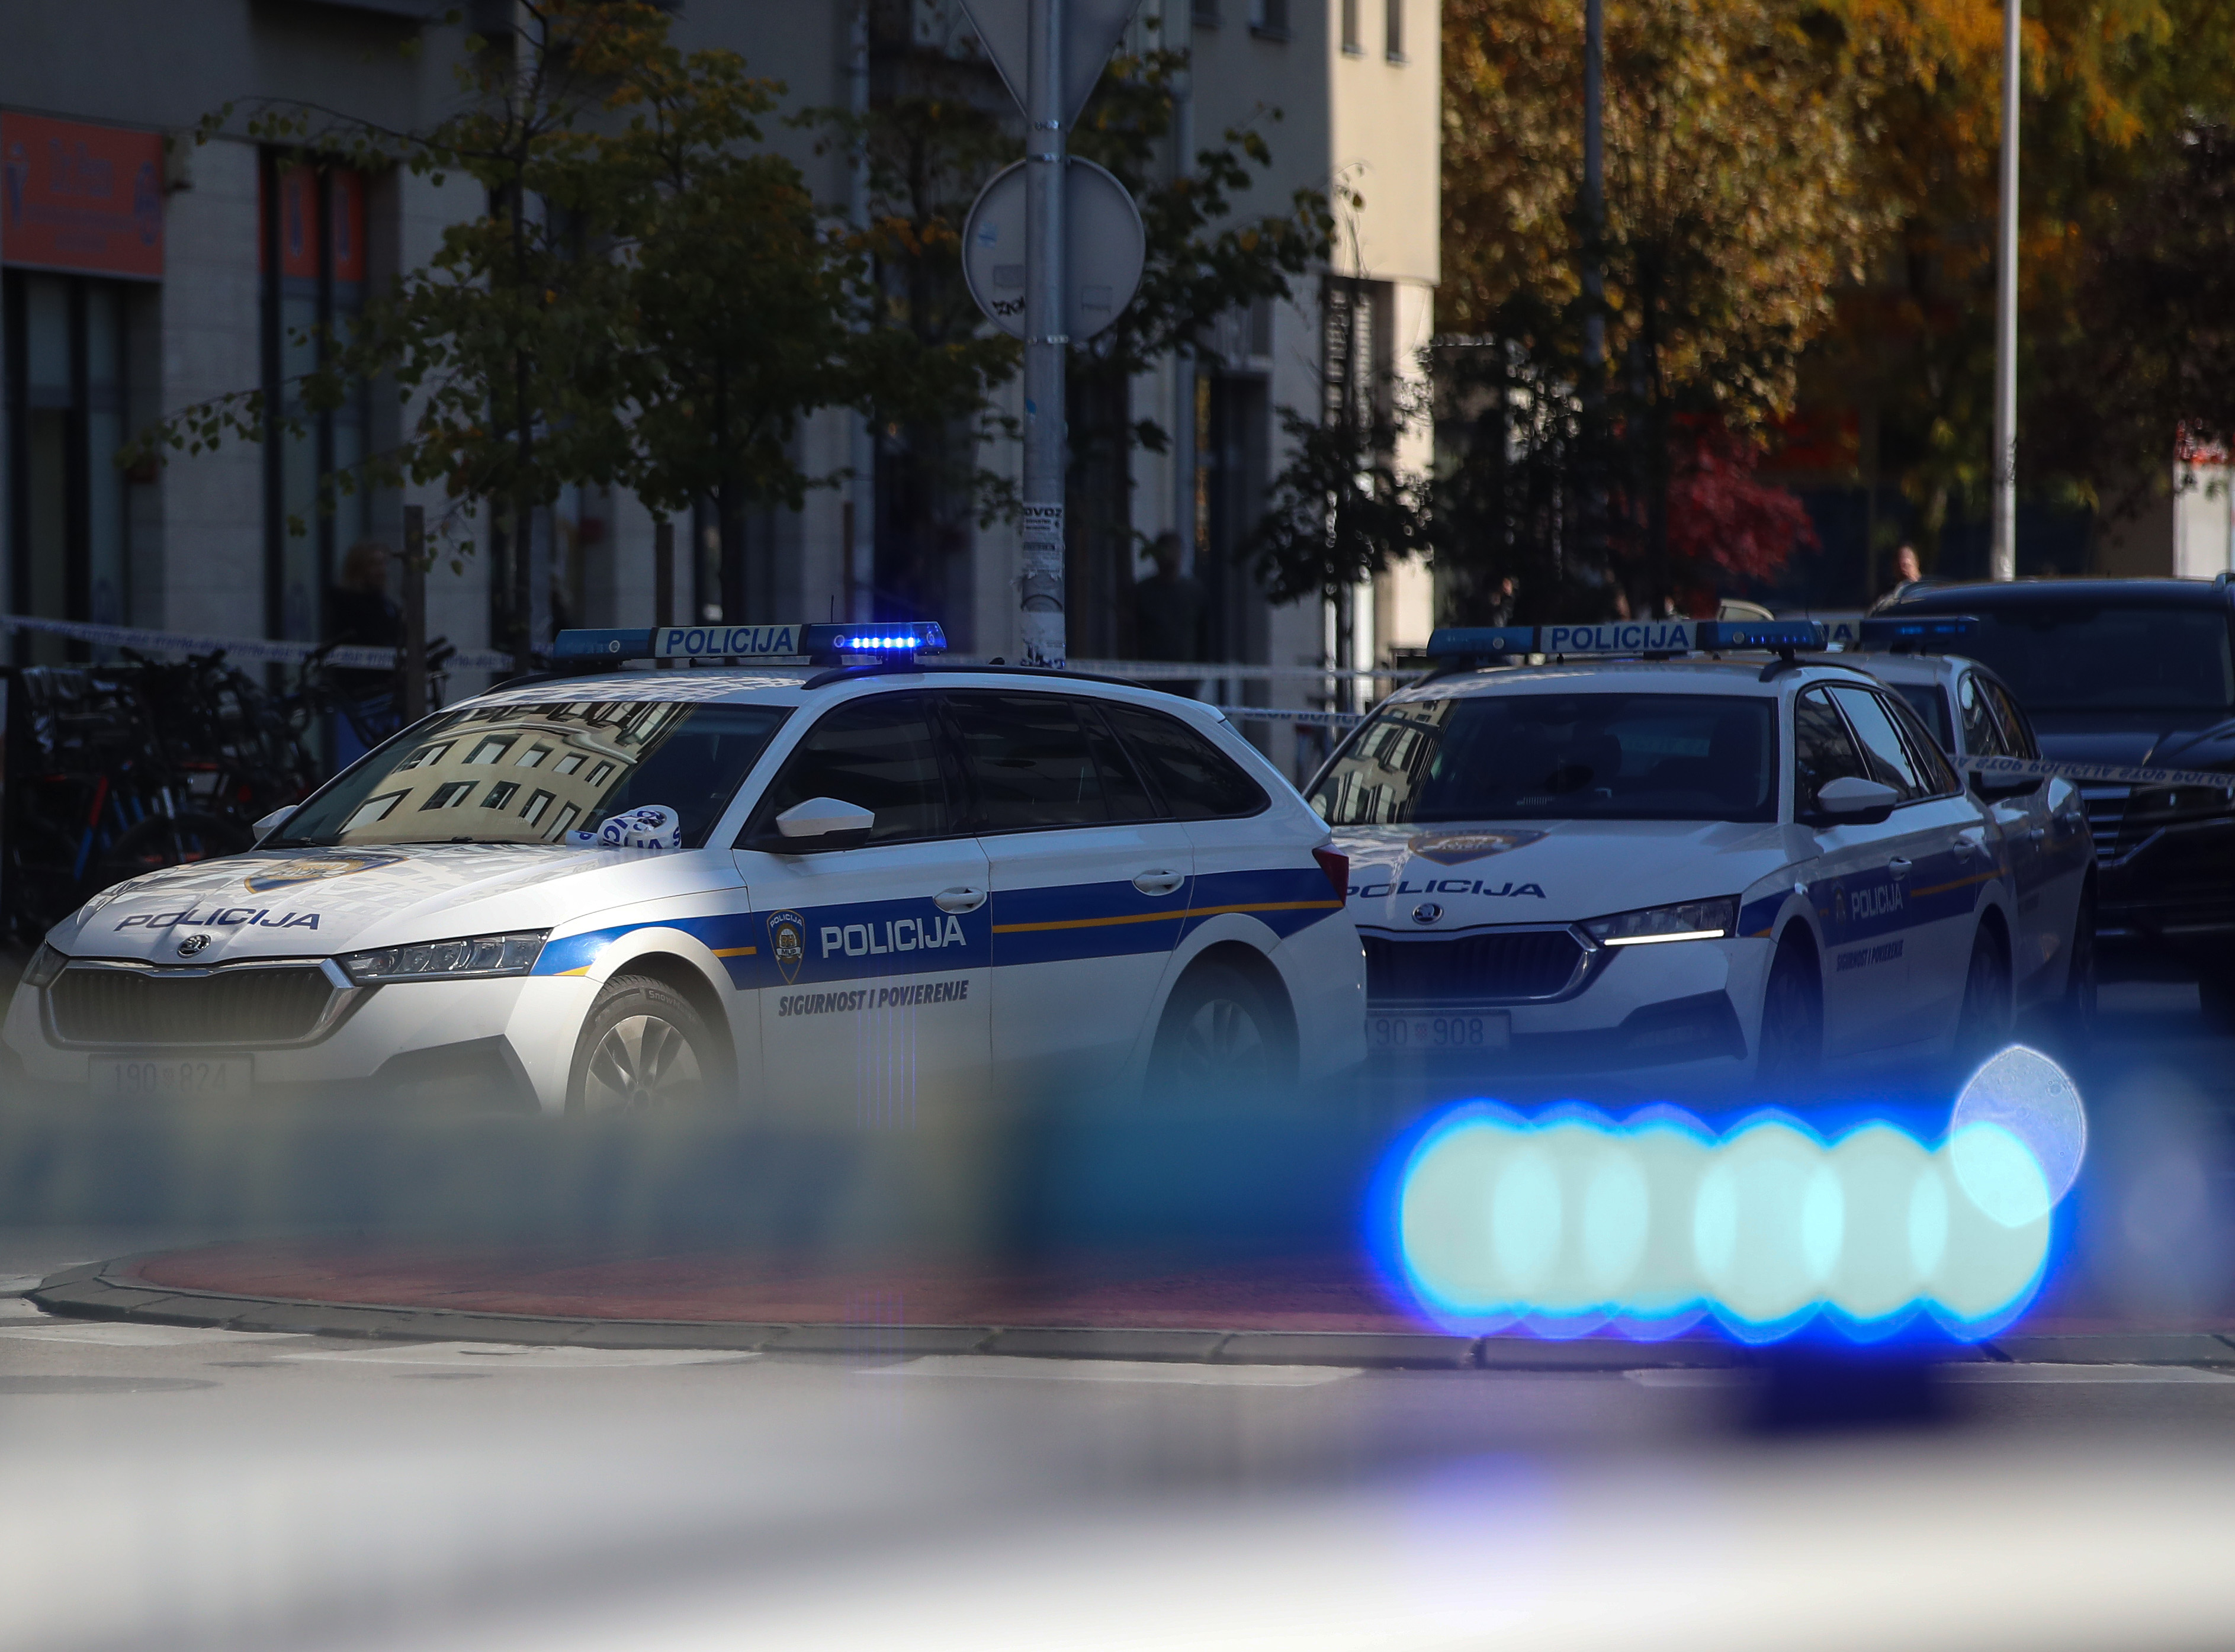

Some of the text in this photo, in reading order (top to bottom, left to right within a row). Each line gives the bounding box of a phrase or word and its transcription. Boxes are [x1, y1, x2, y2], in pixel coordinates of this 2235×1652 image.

[666, 628, 793, 654] POLICIJA
[1551, 624, 1690, 651] POLICIJA
[1851, 883, 1903, 920] POLICIJA
[114, 907, 322, 931] POLICIJA
[770, 914, 802, 928] POLICIJA
[781, 934, 795, 947] RH
[821, 915, 966, 959] POLICIJA
[779, 980, 969, 1017] SIGURNOST I POVJERENJE
[1433, 1017, 1484, 1045] 908
